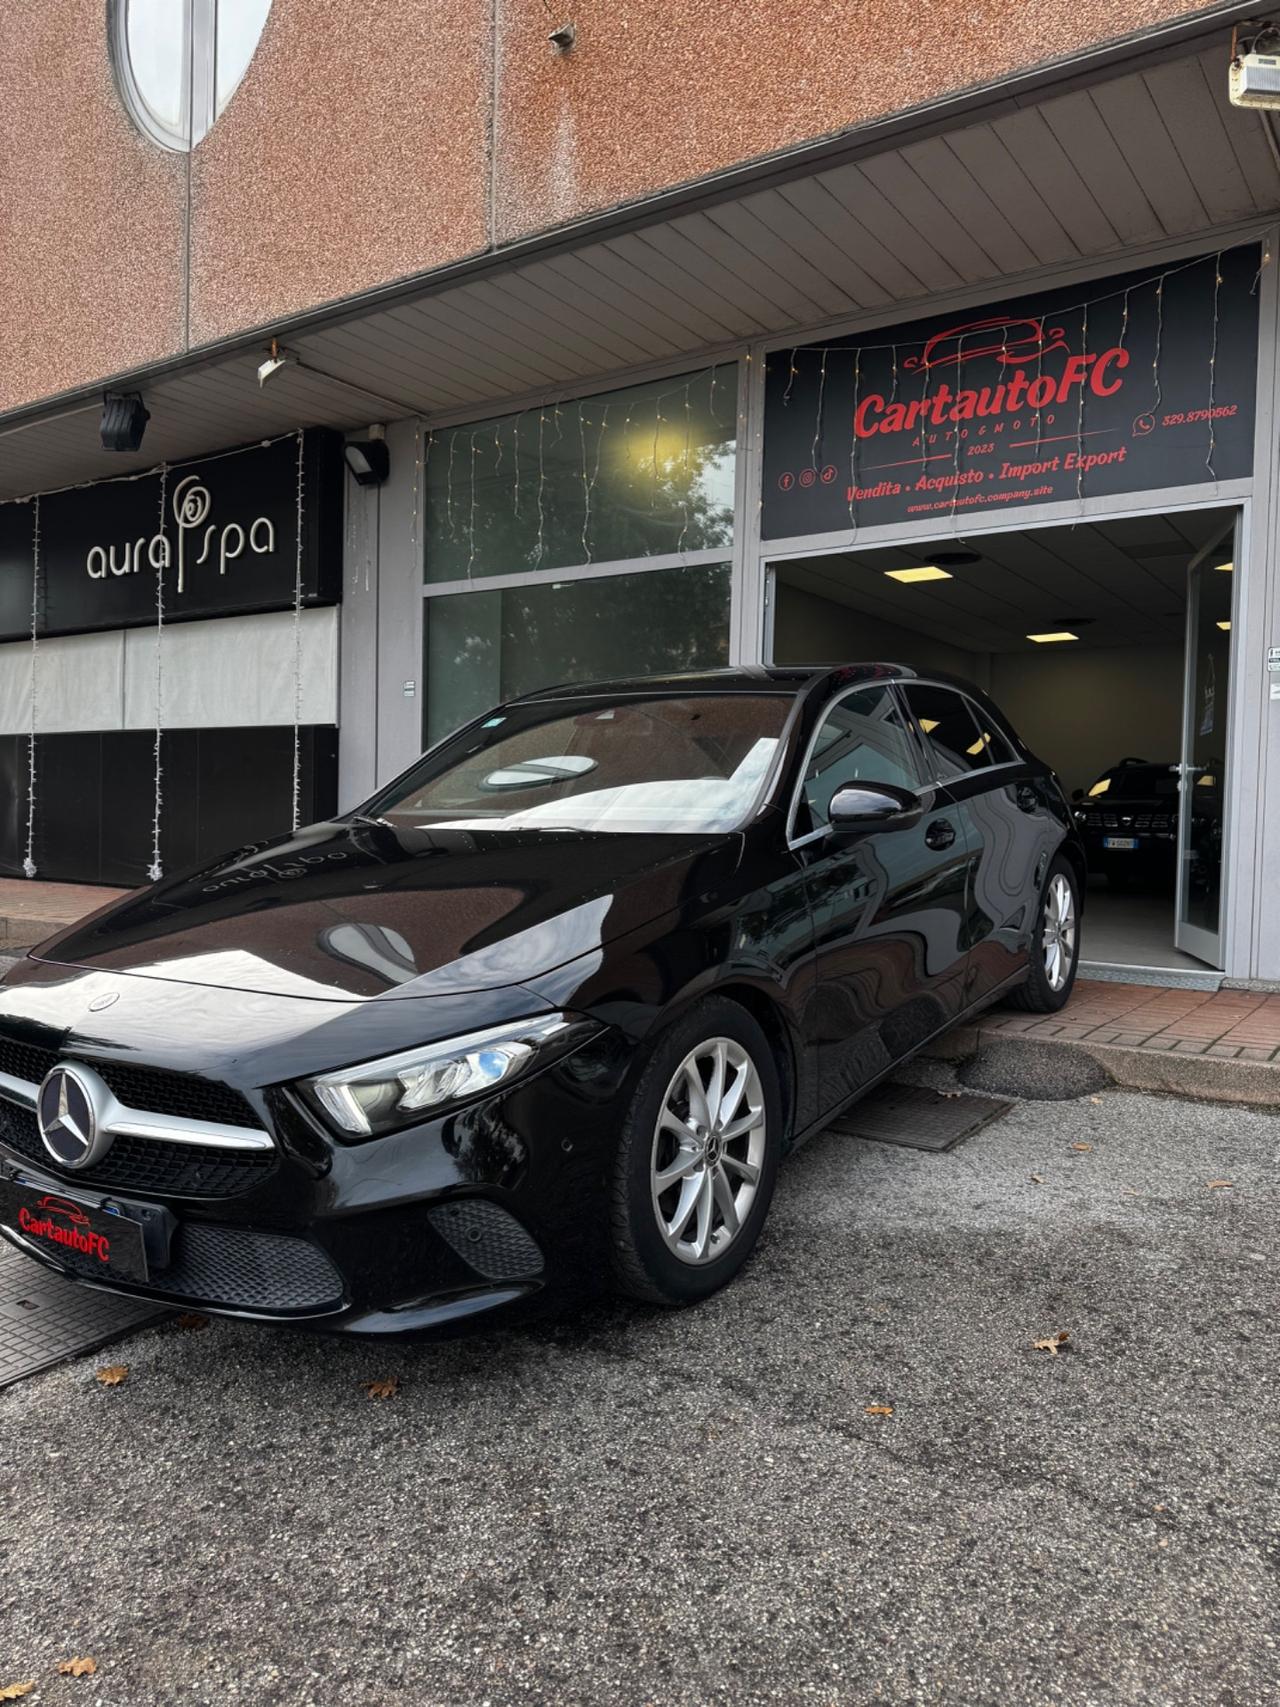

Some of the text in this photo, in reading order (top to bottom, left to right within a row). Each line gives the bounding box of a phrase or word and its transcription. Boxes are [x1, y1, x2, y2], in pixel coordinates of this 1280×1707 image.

[854, 347, 1130, 439] CartautoFC
[846, 446, 1128, 502] Vendita Acquisto Import Export
[86, 517, 275, 579] aura spa
[18, 1206, 111, 1262] CartautoFC
